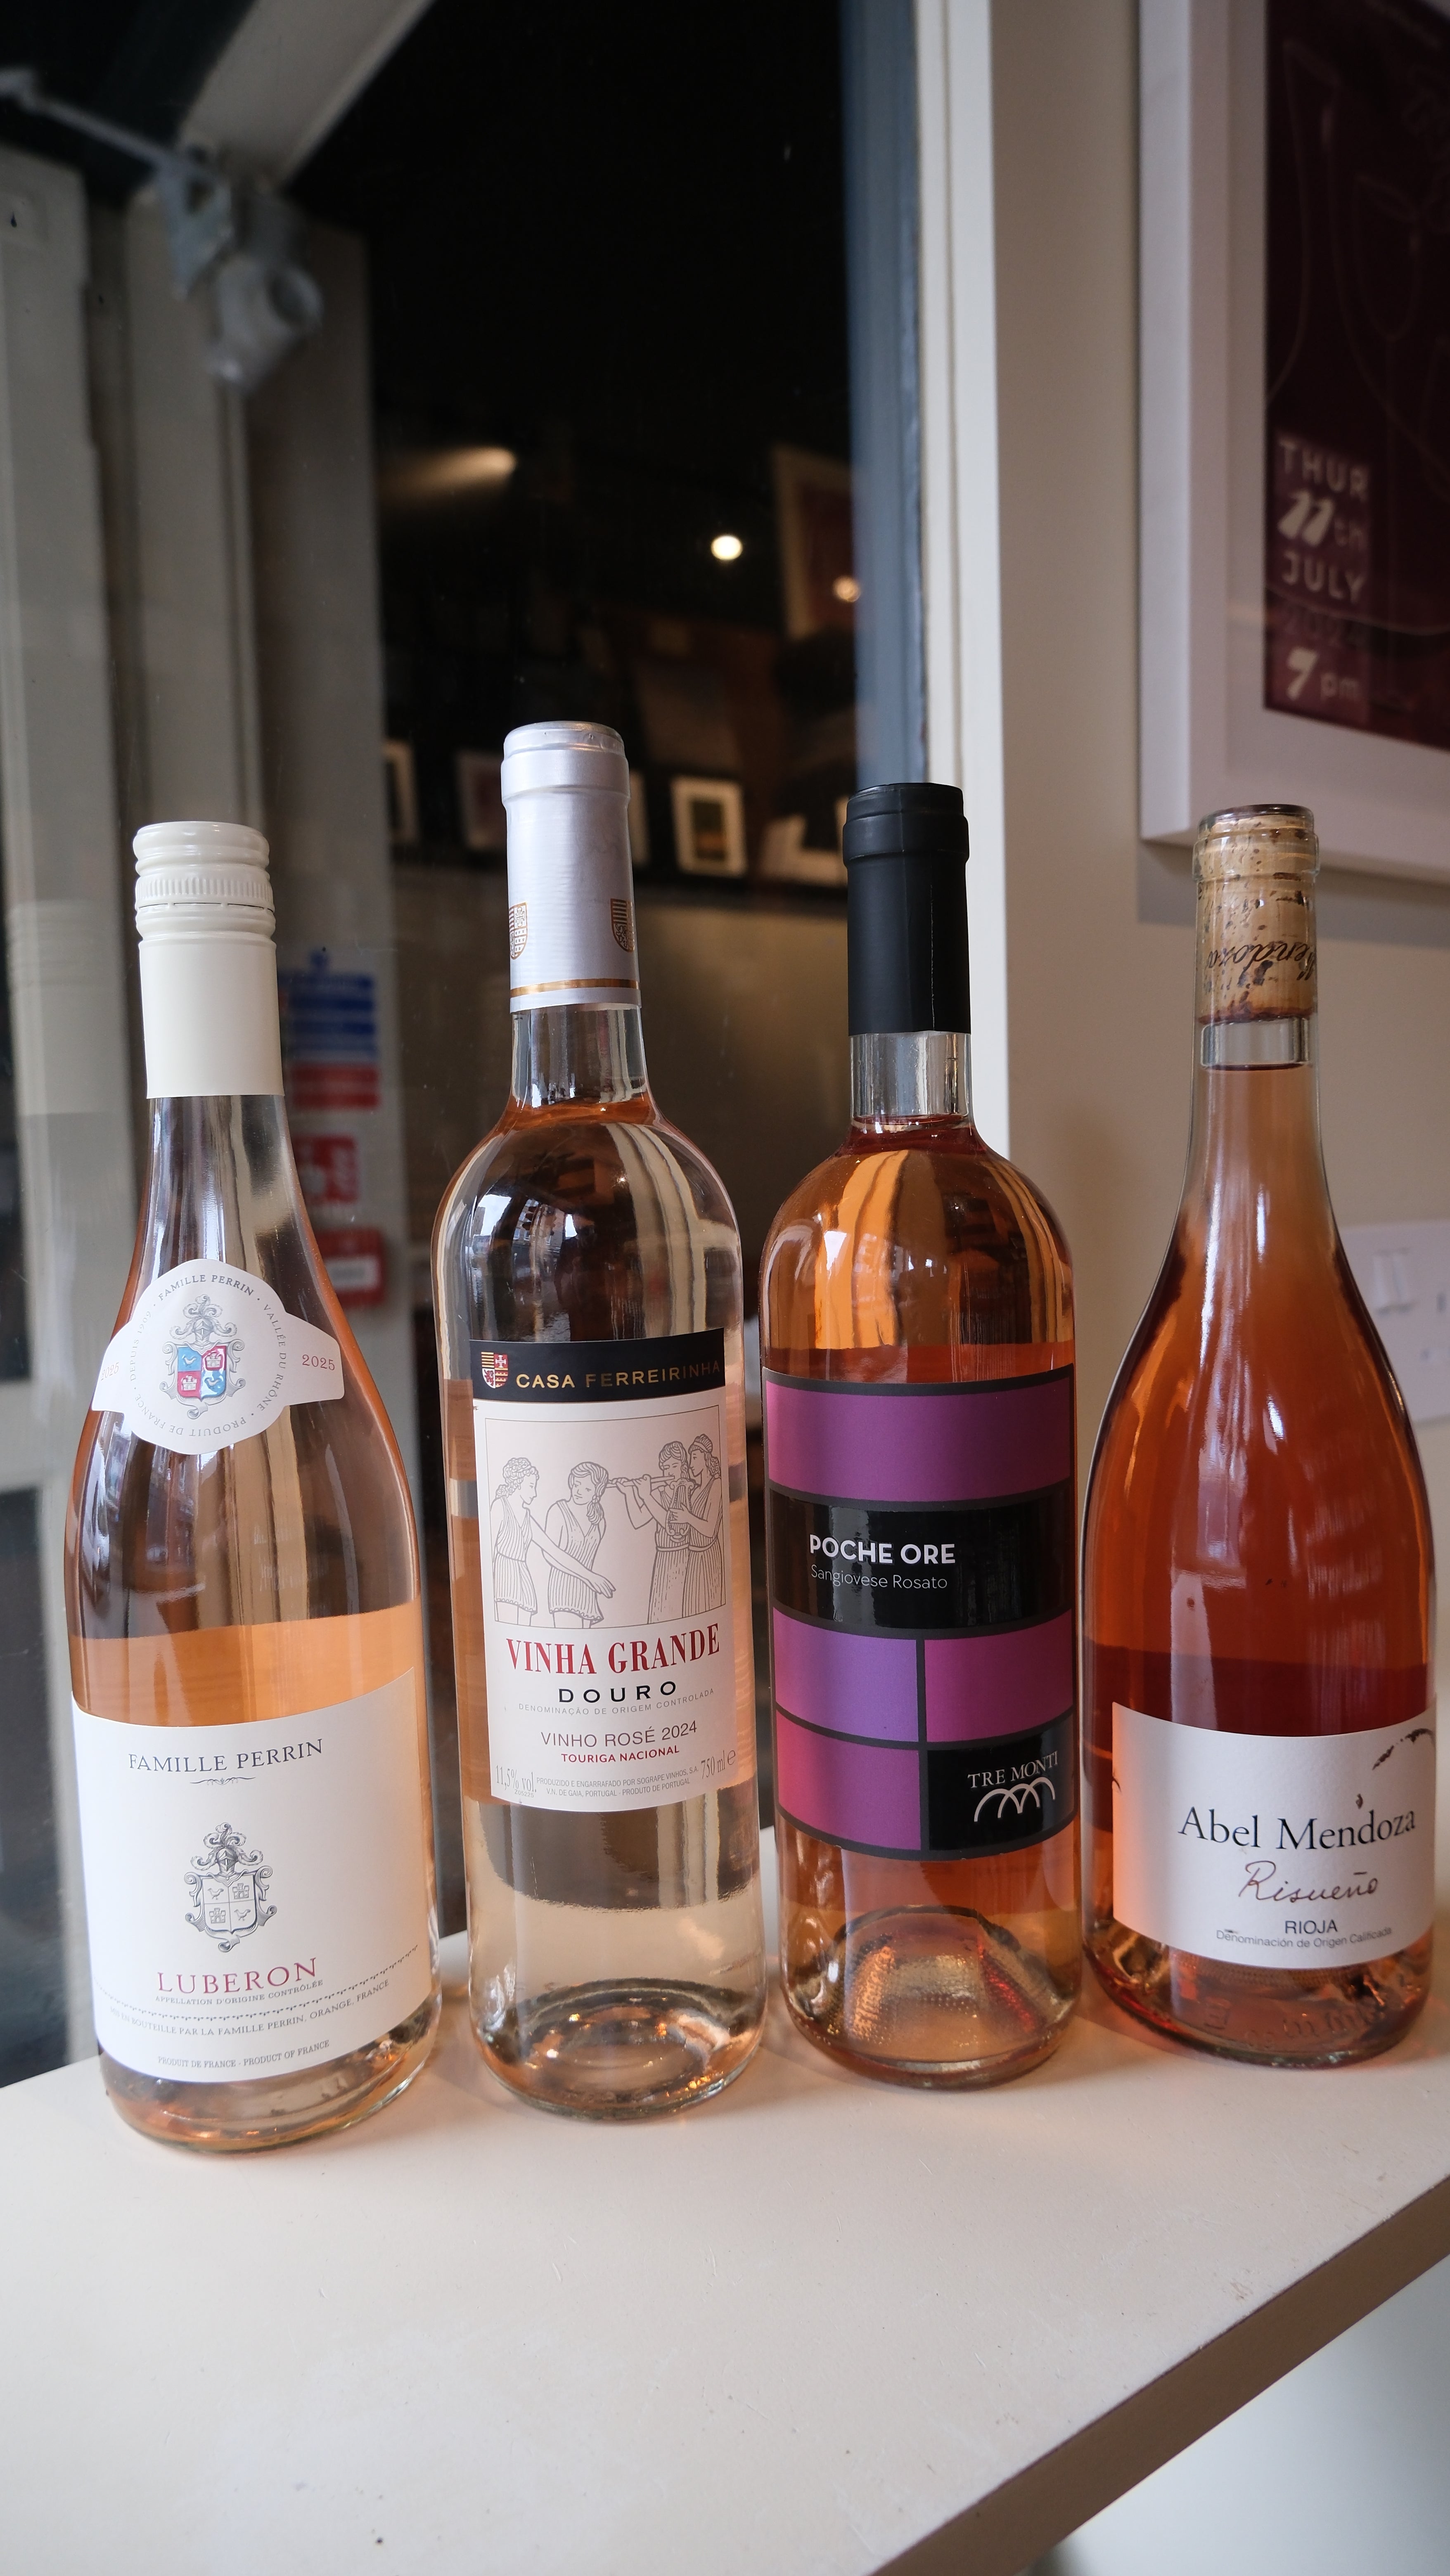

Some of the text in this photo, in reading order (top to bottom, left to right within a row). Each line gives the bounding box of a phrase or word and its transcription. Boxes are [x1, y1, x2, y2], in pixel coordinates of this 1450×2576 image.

[1279, 438, 1369, 501] THUR
[1282, 551, 1365, 605] JULY
[158, 1274, 255, 1301] FAMILLE PERRIN
[130, 1311, 151, 1382] DEPUIS 1909
[256, 1304, 287, 1411] VALLÉE DU RHÔNE
[100, 1362, 119, 1381] 2025
[302, 1354, 335, 1371] 2025
[516, 1360, 720, 1389] CASA FERREIRINHA
[135, 1394, 246, 1437] PRODUIT DE FRANCE
[809, 1534, 956, 1564] POCHE ORE
[811, 1565, 948, 1589] Sangiovese Rosato
[506, 1623, 720, 1675] VINHA GRANDE
[519, 1703, 589, 1716] DENOMINAÇÃO
[612, 1704, 652, 1714] ORIGEM
[656, 1688, 714, 1709] CONTROLADA
[559, 1681, 676, 1703] DOURO
[541, 1720, 697, 1747] VINHO ROSÉ 2024
[128, 1738, 323, 1773] FAMILLE PERRIN
[561, 1745, 680, 1763] TOURIGA NACIONAL
[701, 1756, 715, 1779] 750
[718, 1750, 725, 1773] ml
[495, 1765, 537, 1792] 11,5% vol.
[536, 1777, 569, 1787] PRODUZIDO
[637, 1774, 665, 1785] SOGRAPE
[666, 1770, 688, 1780] VINHOS,
[967, 1751, 1058, 1788] TRE MONTI
[622, 1785, 651, 1796] PRODUTO
[662, 1778, 690, 1790] PORTUGAL
[1178, 1806, 1416, 1851] Abel Mendoza
[1216, 1926, 1392, 1949] Denominación de Origen Calificada
[1285, 1919, 1338, 1934] RIOJA
[157, 1957, 317, 1994] LUBERON
[155, 1979, 323, 2005] APPELLATION D'ORIGINE CONTRÔLÉE
[121, 2011, 130, 2022] EN
[131, 2017, 177, 2034] BOUTEILLE
[179, 2027, 198, 2036] PAR
[201, 2027, 214, 2036] LA
[218, 2023, 264, 2036] FAMILLE
[268, 2015, 307, 2030] PERRIN,
[310, 1998, 354, 2020] ORANGE,
[357, 1979, 389, 2002] FRANCE
[158, 2056, 189, 2067] PRODUIT
[204, 2059, 236, 2068] FRANCE
[244, 2053, 282, 2066] PRODUCT
[284, 2049, 295, 2058] OF
[297, 2039, 329, 2056] FRANCE
